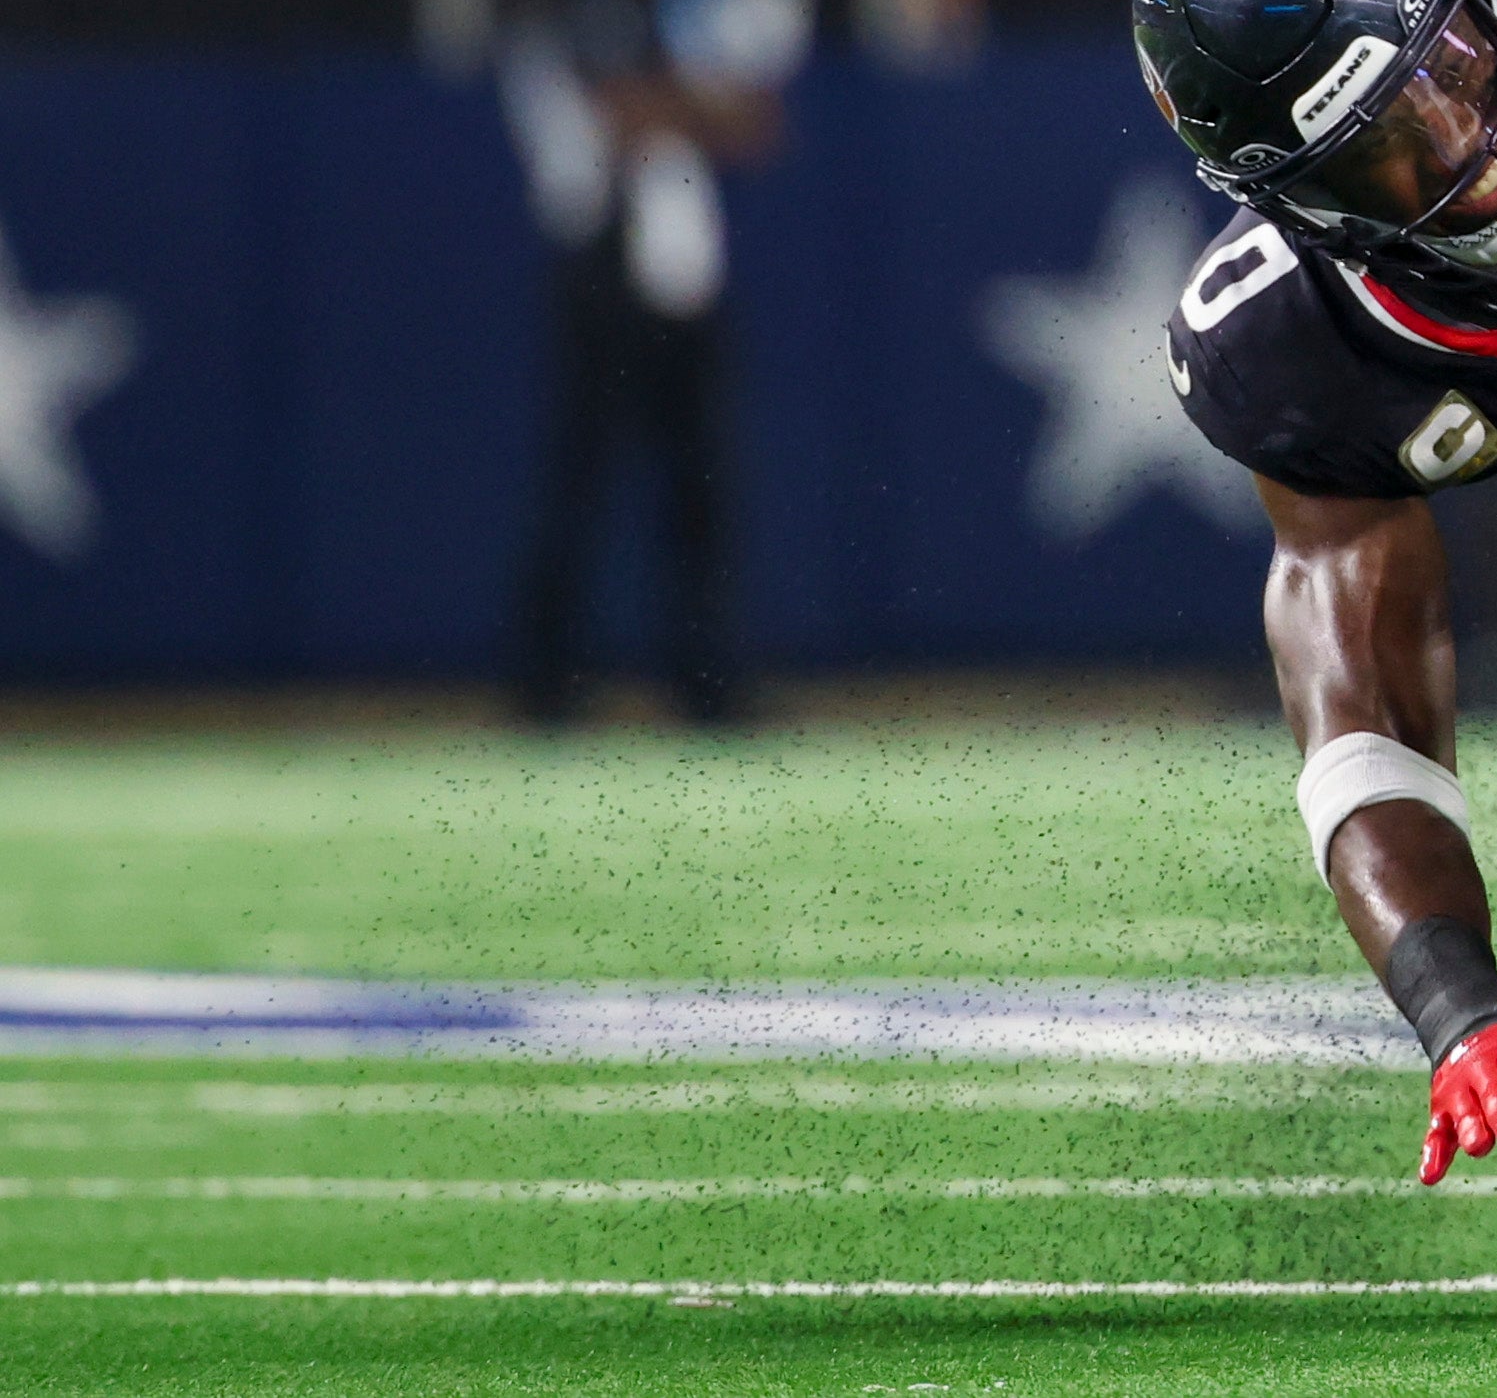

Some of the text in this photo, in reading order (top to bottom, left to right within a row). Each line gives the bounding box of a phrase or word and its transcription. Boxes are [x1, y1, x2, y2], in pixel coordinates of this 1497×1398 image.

[1301, 46, 1372, 123] TEXANS
[1180, 222, 1300, 333] 0
[1410, 403, 1486, 481] C
